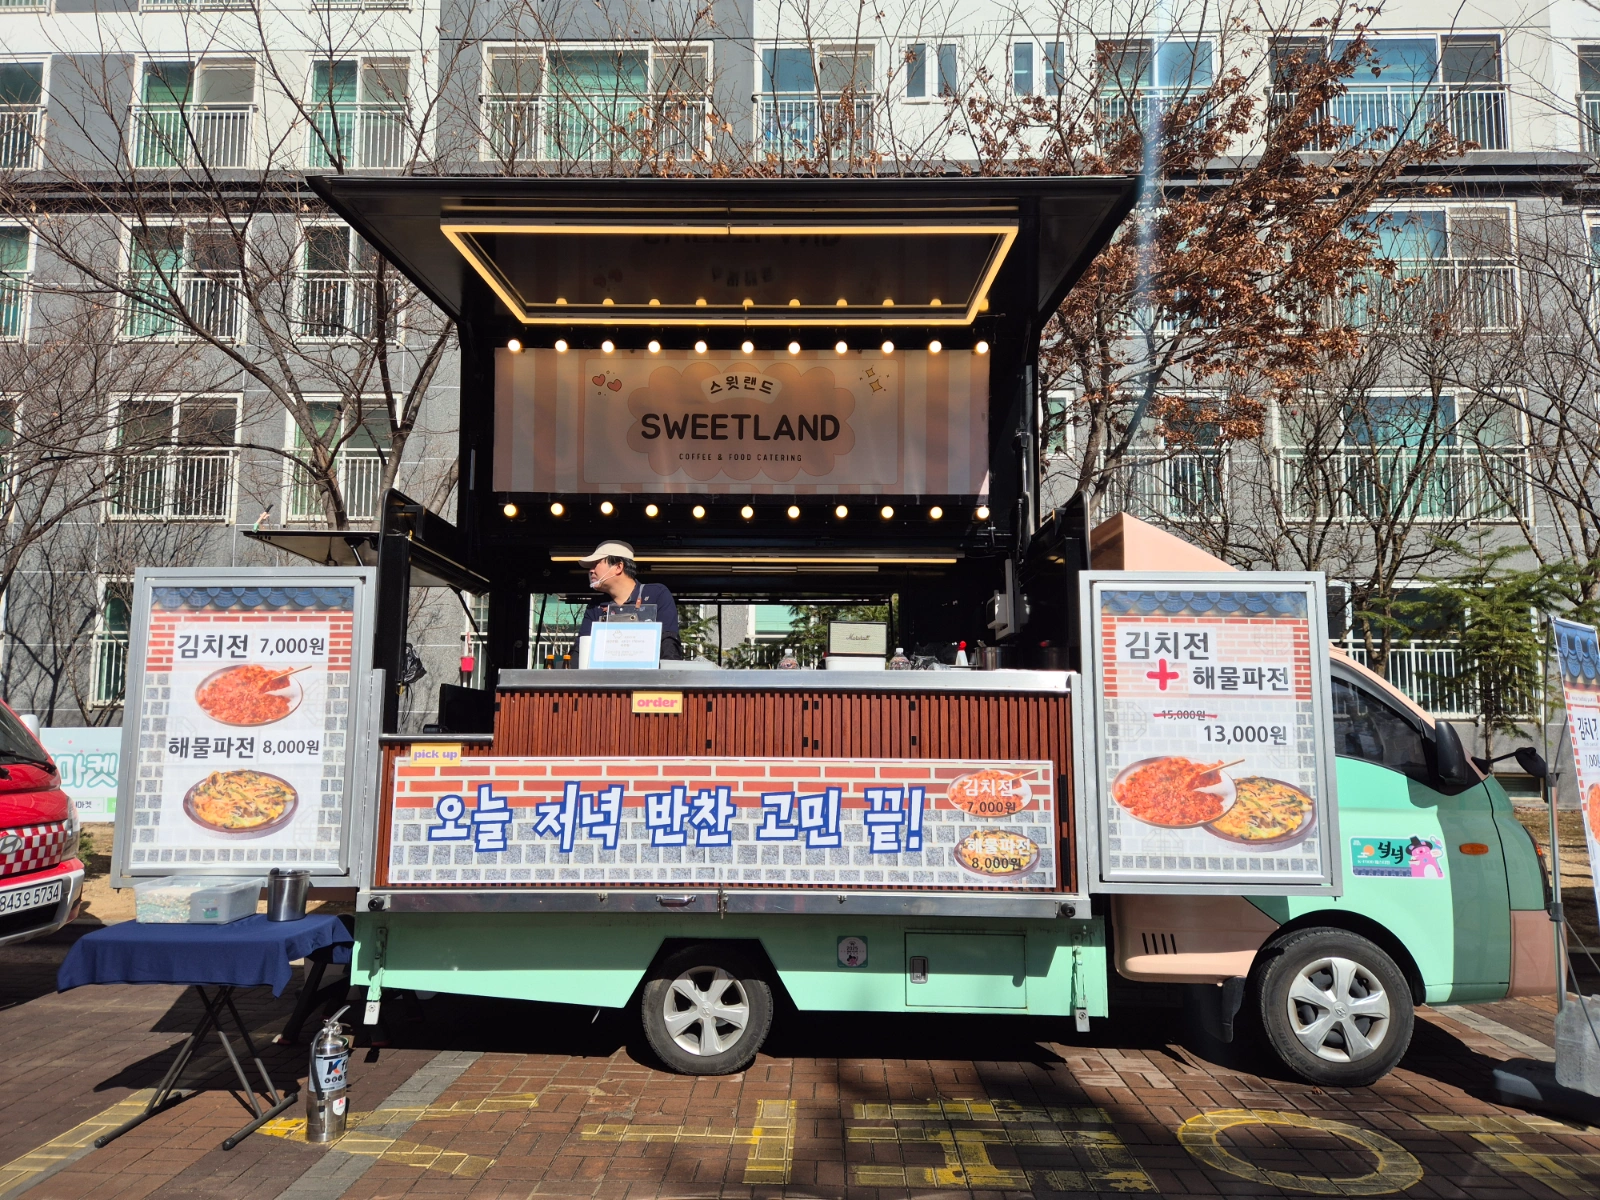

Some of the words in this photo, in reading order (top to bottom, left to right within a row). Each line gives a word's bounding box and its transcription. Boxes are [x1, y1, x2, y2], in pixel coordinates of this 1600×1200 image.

[710, 375, 774, 395] 스윗랜드
[641, 413, 840, 441] SWEETLAND
[679, 453, 712, 461] COFFEE
[717, 453, 723, 461] &
[728, 453, 752, 461] FOOD
[757, 454, 802, 462] CATERING
[177, 634, 249, 659] 김치전
[259, 637, 325, 656] 7,000원
[1125, 631, 1210, 660] 김치전
[1192, 665, 1289, 692] 해물파전
[636, 697, 678, 709] order
[1203, 725, 1287, 746] 13,000원
[168, 737, 255, 759] 해물파전
[262, 740, 319, 756] 8,000원
[413, 750, 439, 761] pick
[442, 751, 458, 762] up
[963, 779, 1014, 796] 김치전
[428, 783, 513, 853] 오늘
[532, 781, 624, 853] 저녁
[645, 786, 737, 848] 반찬
[756, 786, 842, 849] 고민
[864, 786, 926, 854] 끝!
[967, 801, 1016, 815] 7,000원
[965, 838, 1031, 855] 해물파전
[971, 858, 1022, 871] 8,000원
[33, 884, 60, 905] 5734
